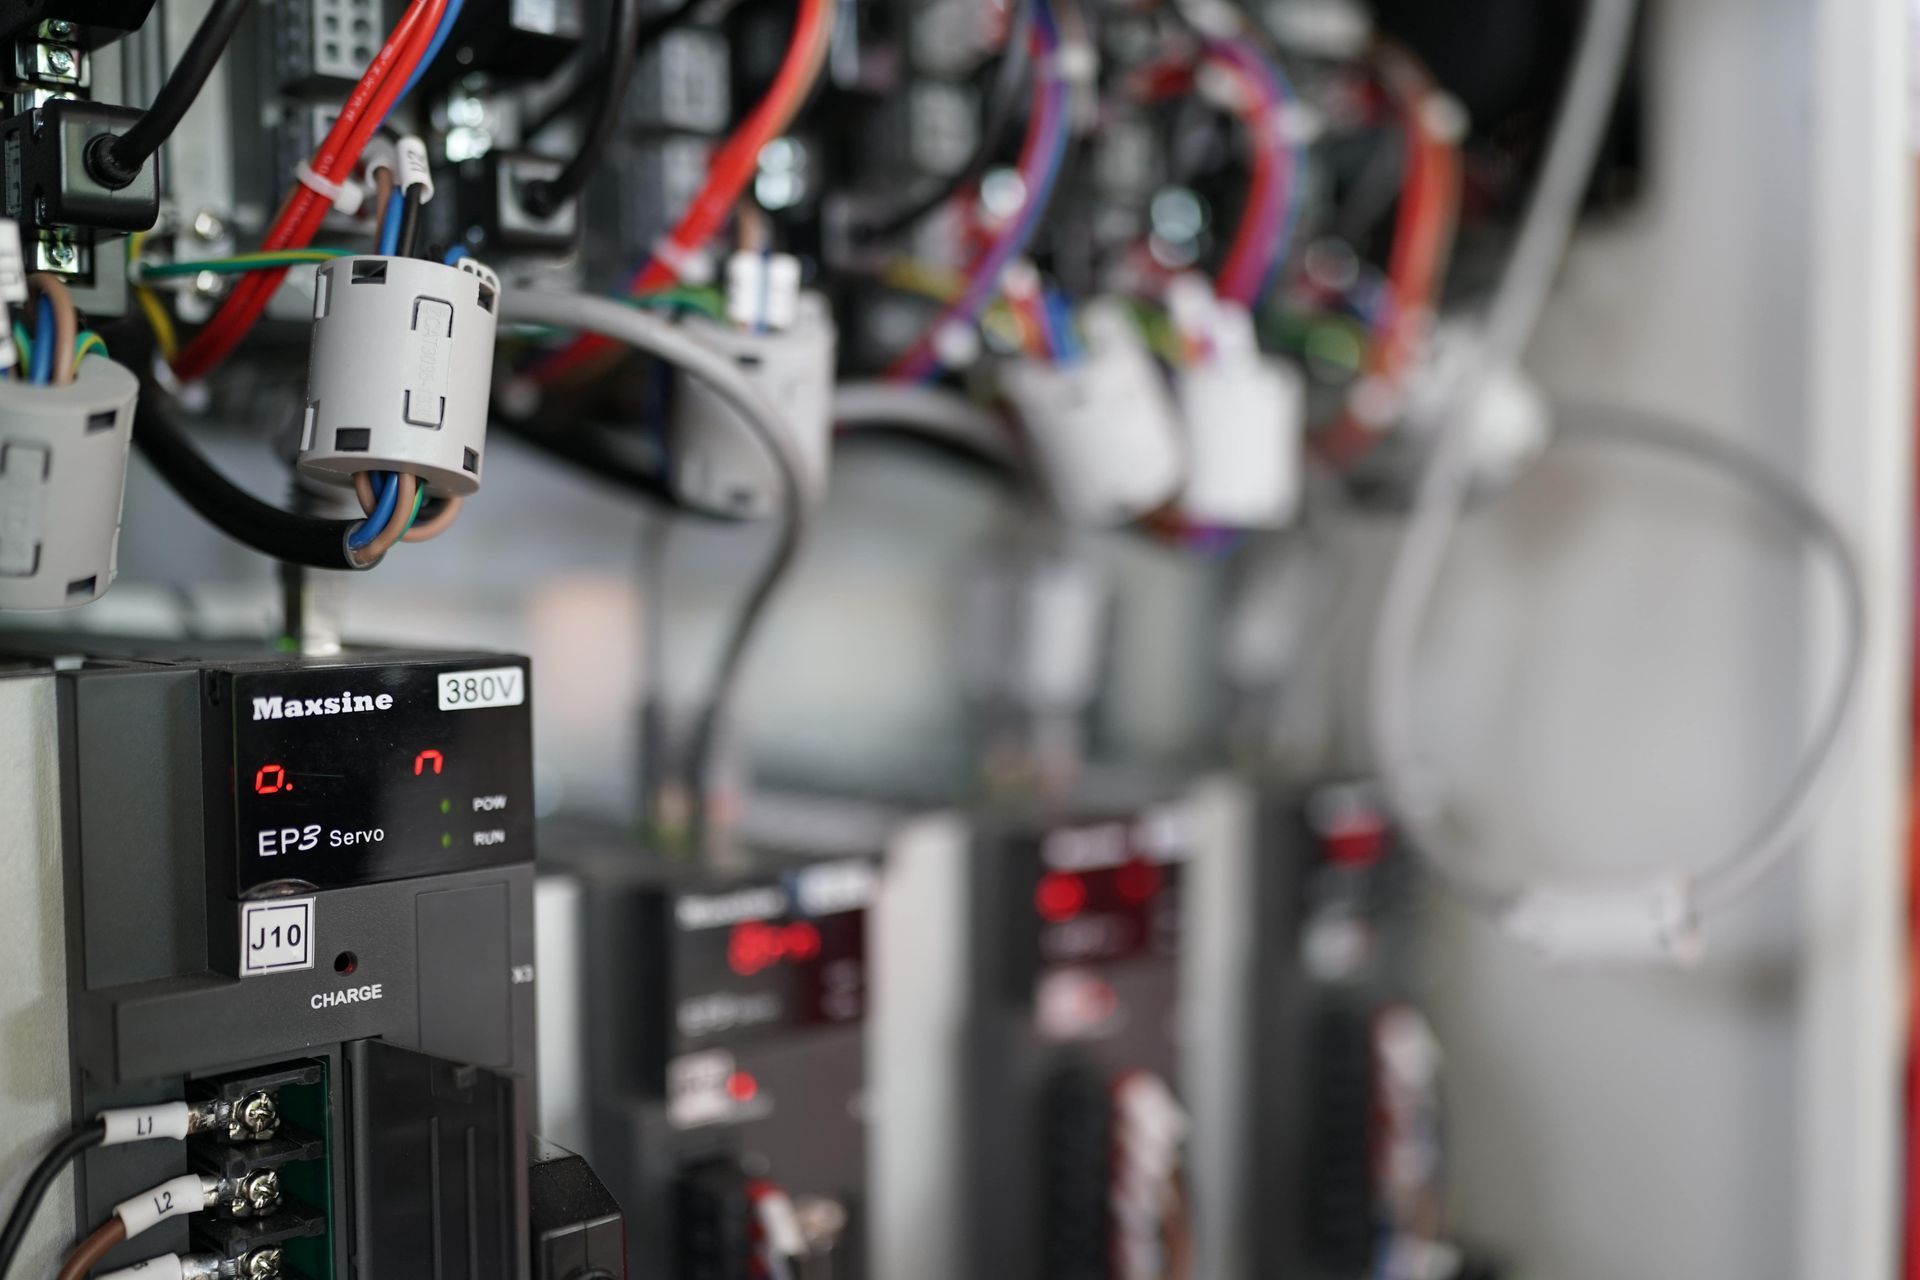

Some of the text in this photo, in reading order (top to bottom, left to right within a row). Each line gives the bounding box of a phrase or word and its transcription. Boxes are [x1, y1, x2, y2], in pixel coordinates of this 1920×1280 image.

[447, 674, 516, 703] 380V
[252, 691, 394, 720] Maxsine
[472, 794, 508, 812] POW
[258, 824, 385, 857] EP3 Servo
[472, 829, 506, 846] RUN
[251, 924, 302, 950] J10
[310, 983, 383, 1010] CHARGE
[136, 1116, 153, 1136] L1
[154, 1191, 175, 1215] L2
